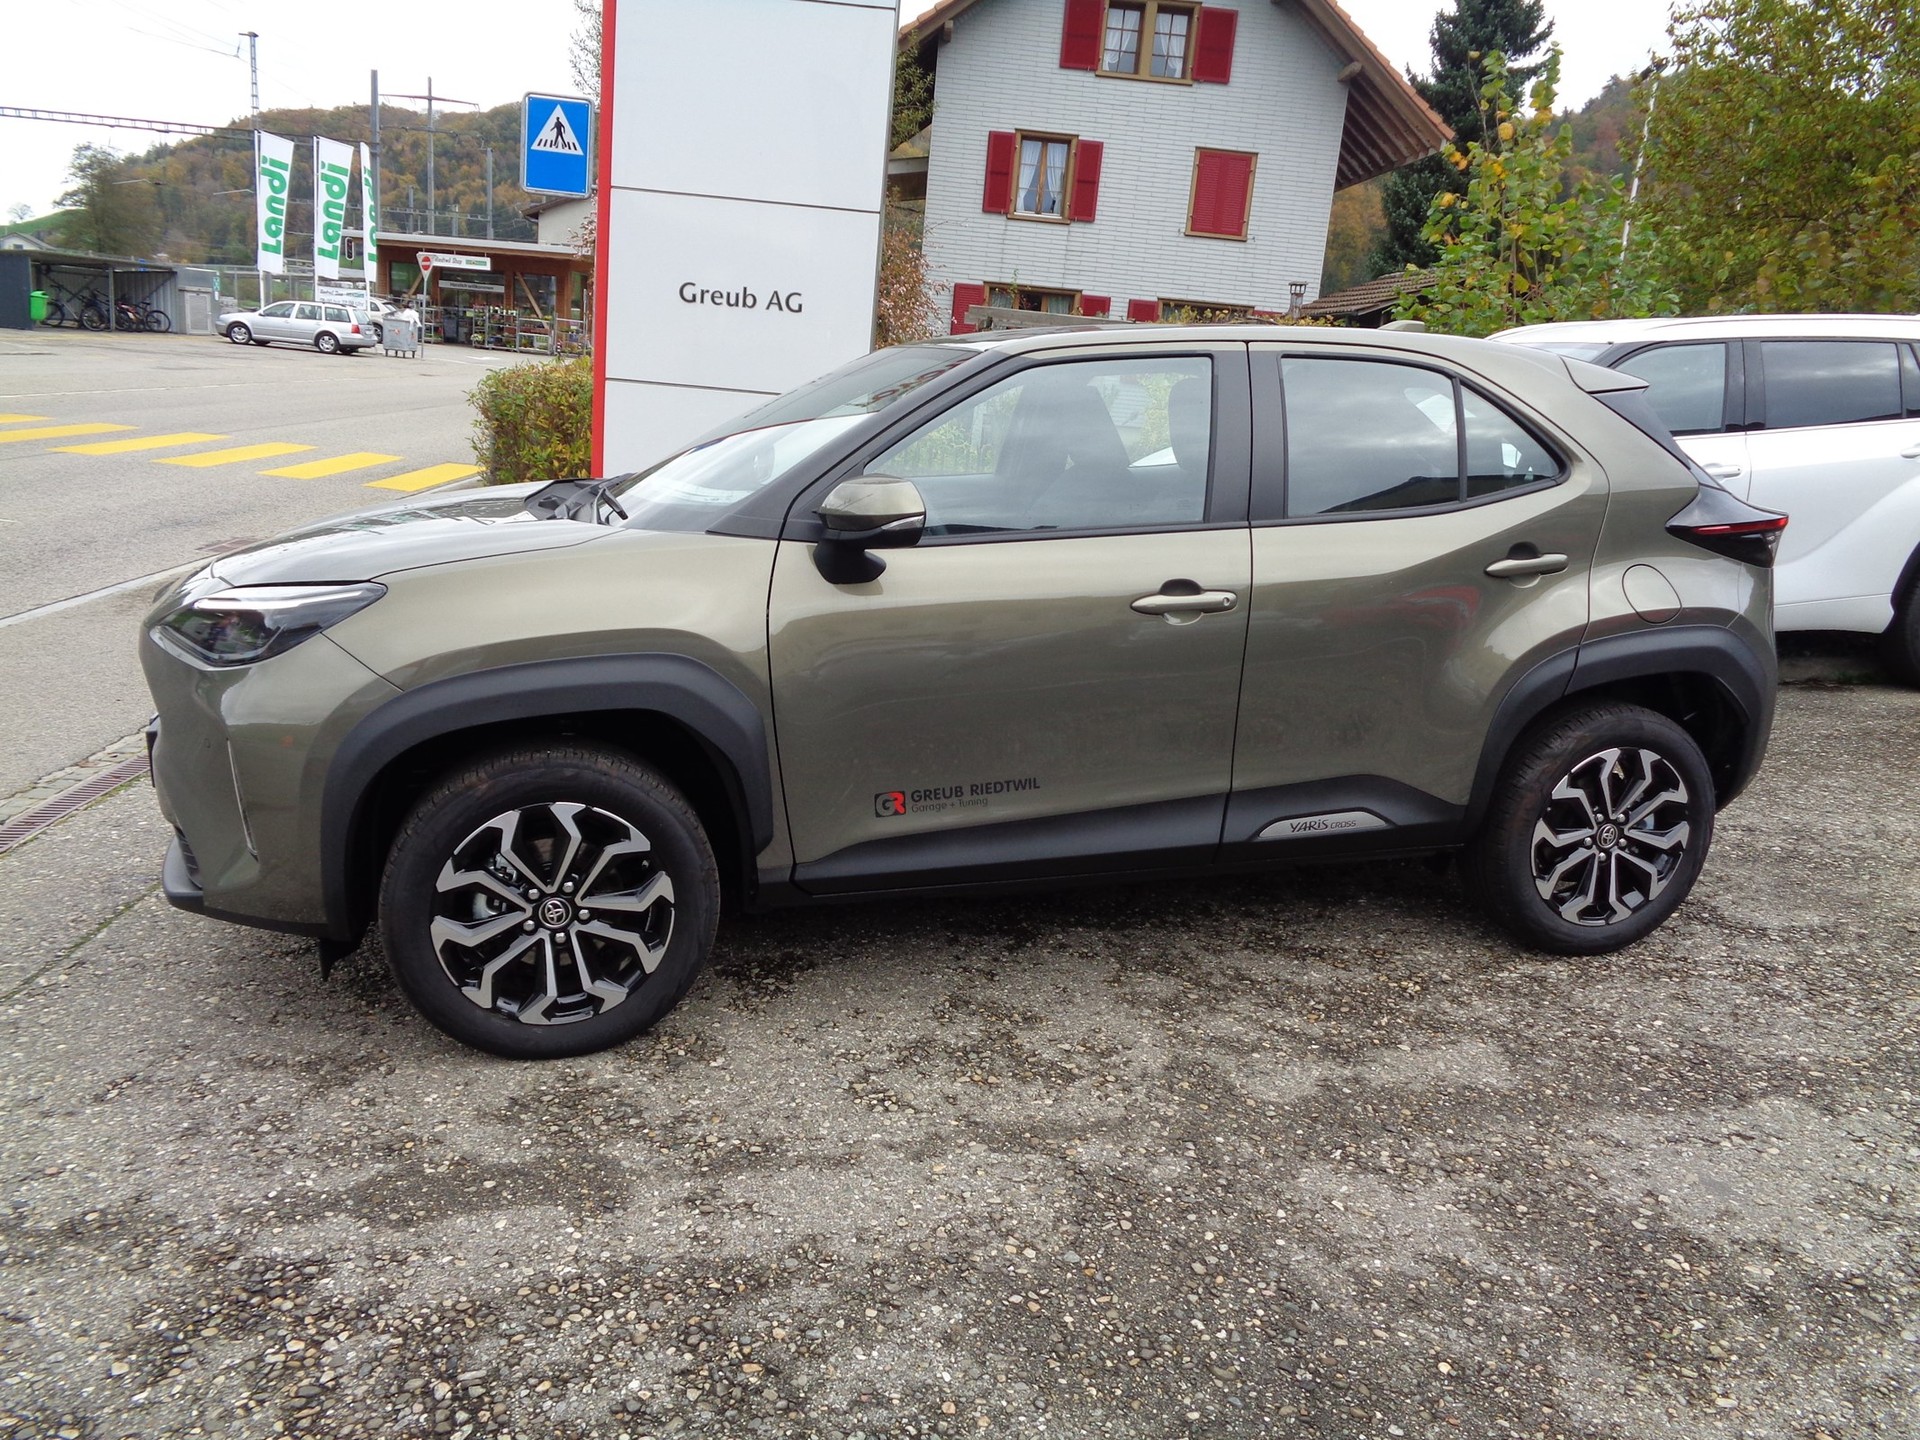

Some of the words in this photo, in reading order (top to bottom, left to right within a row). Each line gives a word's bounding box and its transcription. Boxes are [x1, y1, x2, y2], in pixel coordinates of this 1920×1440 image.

[261, 155, 290, 255] Landi
[317, 161, 349, 260] Landi
[678, 281, 757, 309] Greub
[765, 290, 803, 313] AG
[911, 785, 964, 803] GREUB
[970, 777, 1040, 796] RIEDTWIL
[911, 802, 947, 814] Garage
[958, 797, 989, 808] Tuning
[1290, 818, 1329, 833] YARIS
[1330, 819, 1357, 829] CROSS
